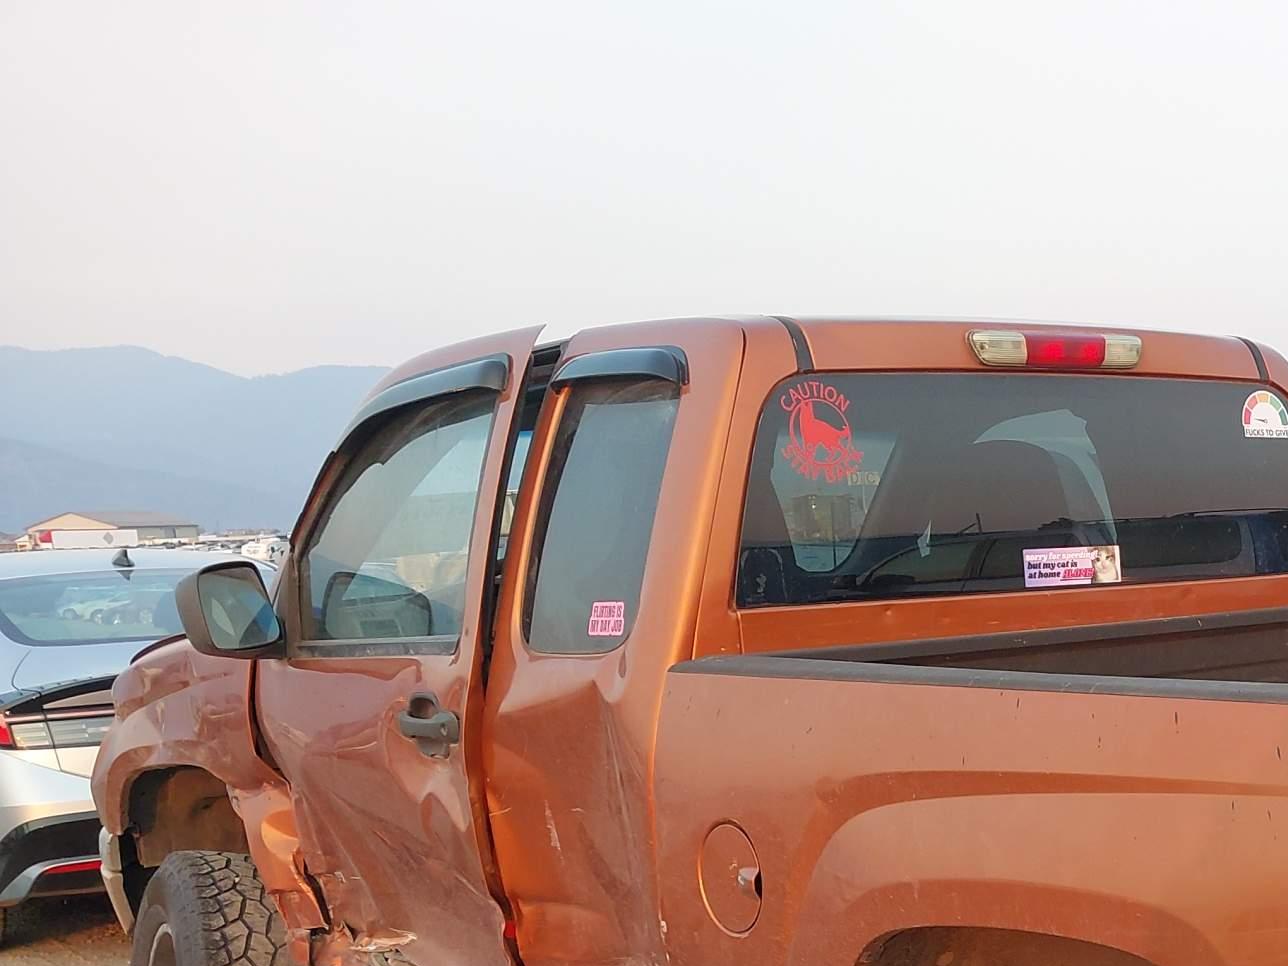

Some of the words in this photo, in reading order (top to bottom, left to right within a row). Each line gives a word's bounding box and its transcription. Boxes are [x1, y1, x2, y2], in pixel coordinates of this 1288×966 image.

[780, 381, 850, 412] CAUTION
[1246, 428, 1264, 437] FUCKS
[1266, 429, 1273, 437] TO
[1275, 429, 1288, 437] GIVE
[1025, 553, 1048, 562] sorry
[1048, 551, 1060, 560] for
[1027, 561, 1041, 570] but
[1042, 562, 1056, 570] my
[1057, 560, 1069, 568] cat
[1070, 559, 1078, 568] is
[1027, 571, 1037, 579] at
[1038, 570, 1061, 579] home
[593, 605, 616, 618] FLIRTING
[616, 604, 623, 618] IS
[590, 619, 599, 633] MY
[600, 619, 611, 633] DAY
[611, 619, 623, 633] JOB
